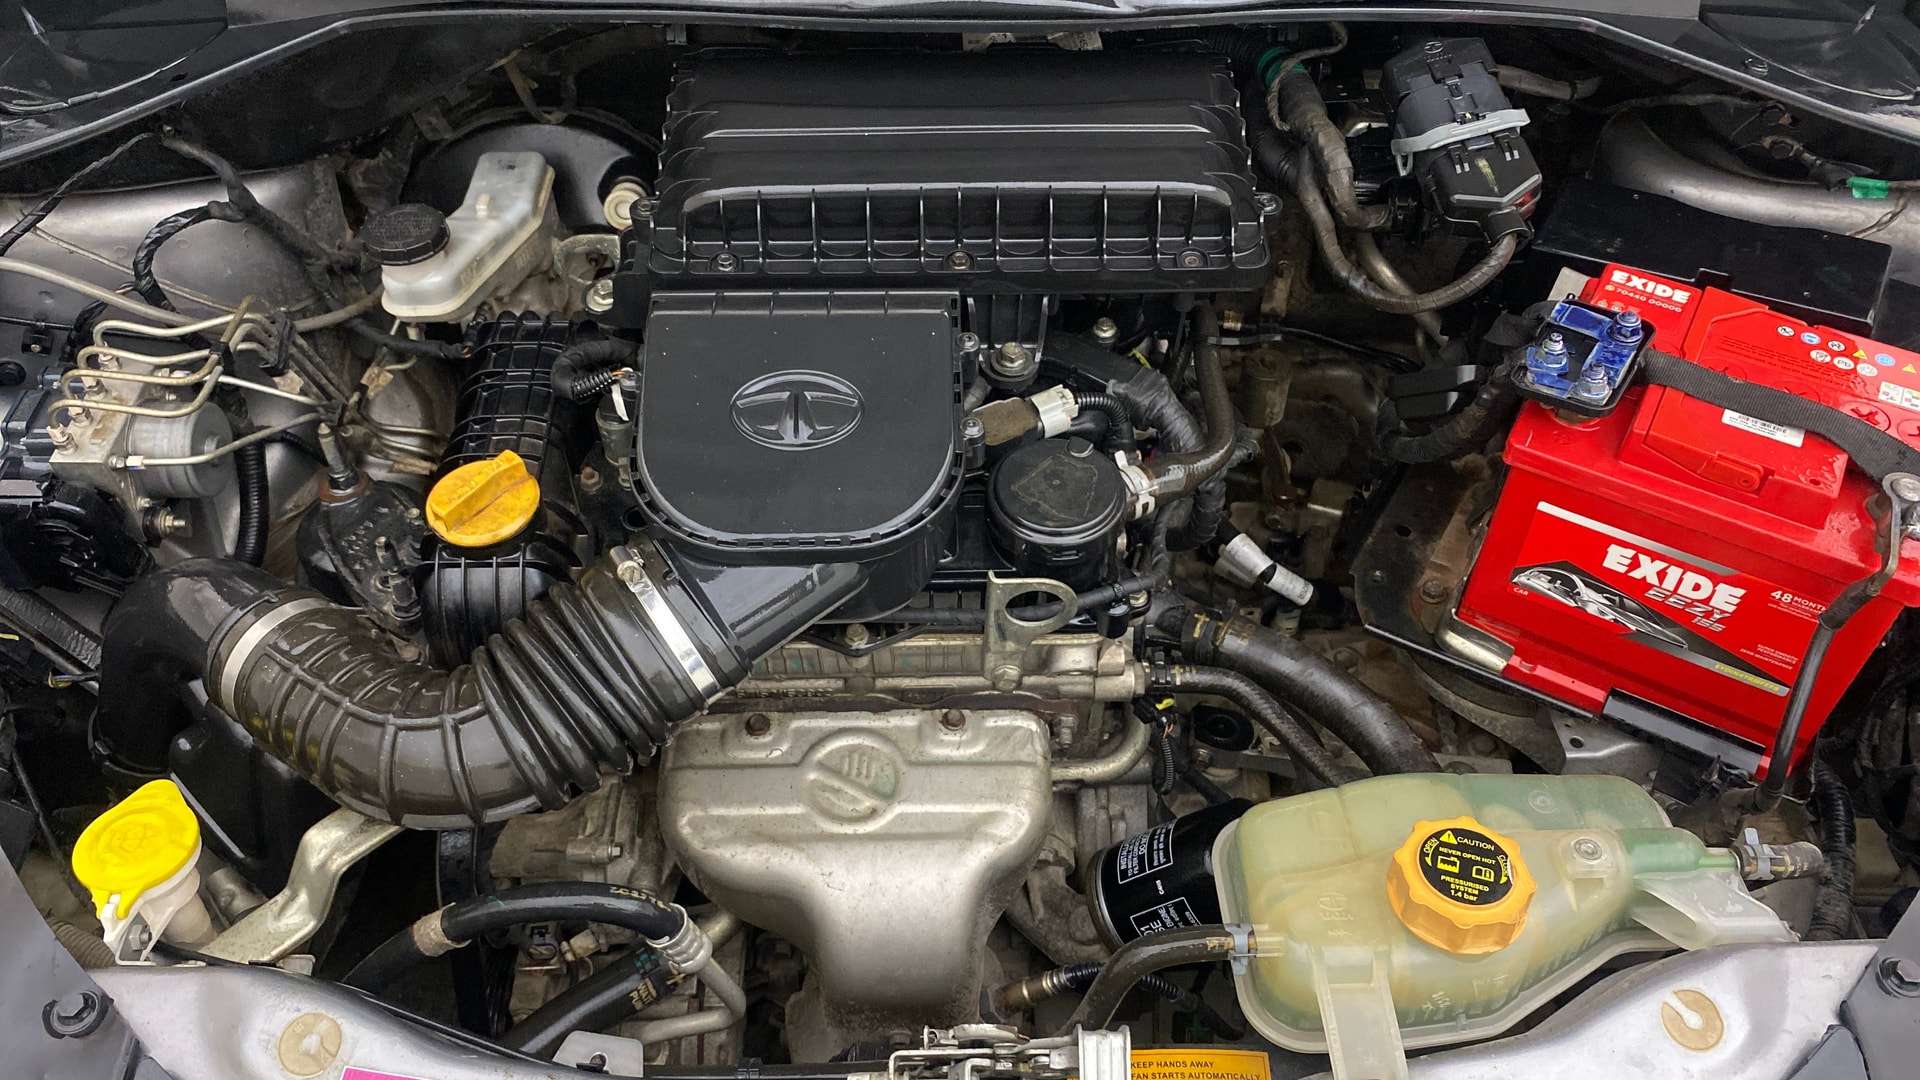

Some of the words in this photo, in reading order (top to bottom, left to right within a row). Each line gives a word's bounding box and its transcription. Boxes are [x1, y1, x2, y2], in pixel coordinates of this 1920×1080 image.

[1610, 269, 1692, 304] EXIDE
[1615, 288, 1647, 302] 70440
[1648, 298, 1682, 312] 00000
[1602, 543, 1747, 613] EXIDE
[1770, 590, 1793, 603] 48
[1457, 836, 1495, 851] CAUTION
[1439, 846, 1462, 857] NEVER
[1462, 852, 1481, 862] OPEN
[1481, 858, 1497, 866] HOT
[1440, 874, 1490, 892] PRESSURISED
[1450, 883, 1479, 895] SYSTEM
[1450, 889, 1462, 898] 1.4
[1463, 893, 1478, 902] bar
[1130, 1061, 1153, 1069] KEEP
[1131, 1072, 1149, 1080] FAN
[1151, 1072, 1186, 1080] STARTS
[1188, 1072, 1260, 1080] AUTOMATICALLY
